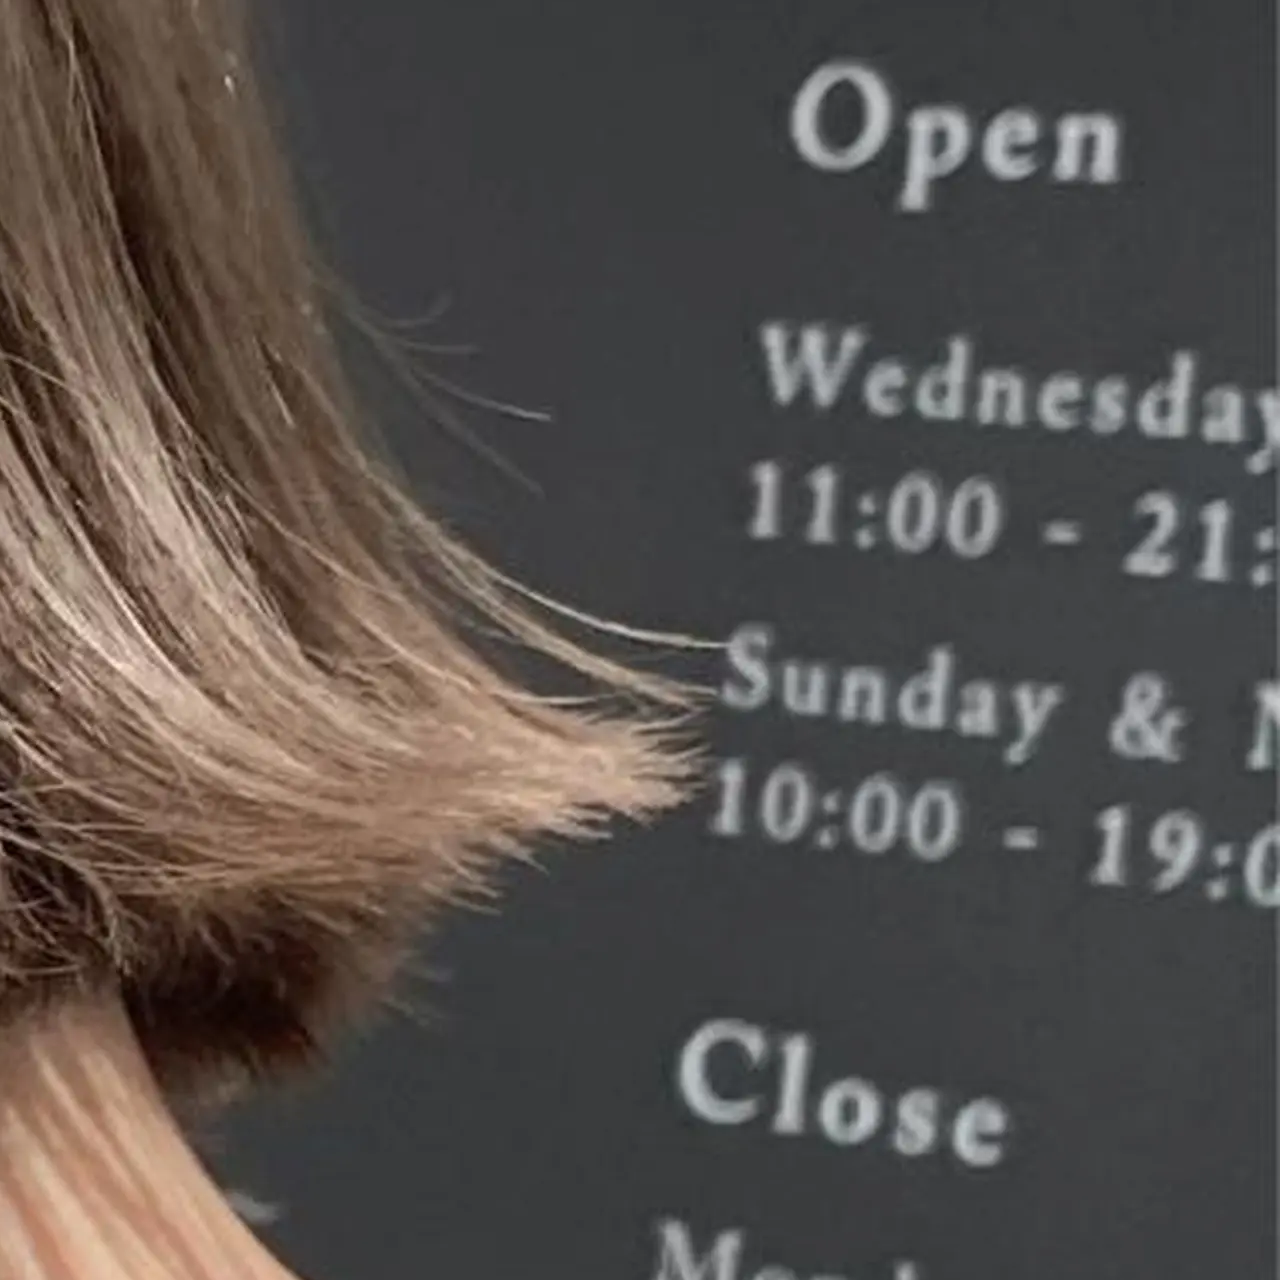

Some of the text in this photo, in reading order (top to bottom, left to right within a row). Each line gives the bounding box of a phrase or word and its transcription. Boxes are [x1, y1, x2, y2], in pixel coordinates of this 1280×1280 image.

[788, 60, 1123, 214] Open
[748, 460, 1003, 559] 11:00
[1042, 519, 1082, 546] -
[720, 623, 1064, 766] Sunday
[1106, 671, 1187, 764] &
[710, 757, 963, 862] 10:00
[1002, 826, 1040, 851] -
[676, 1017, 1010, 1168] Close
